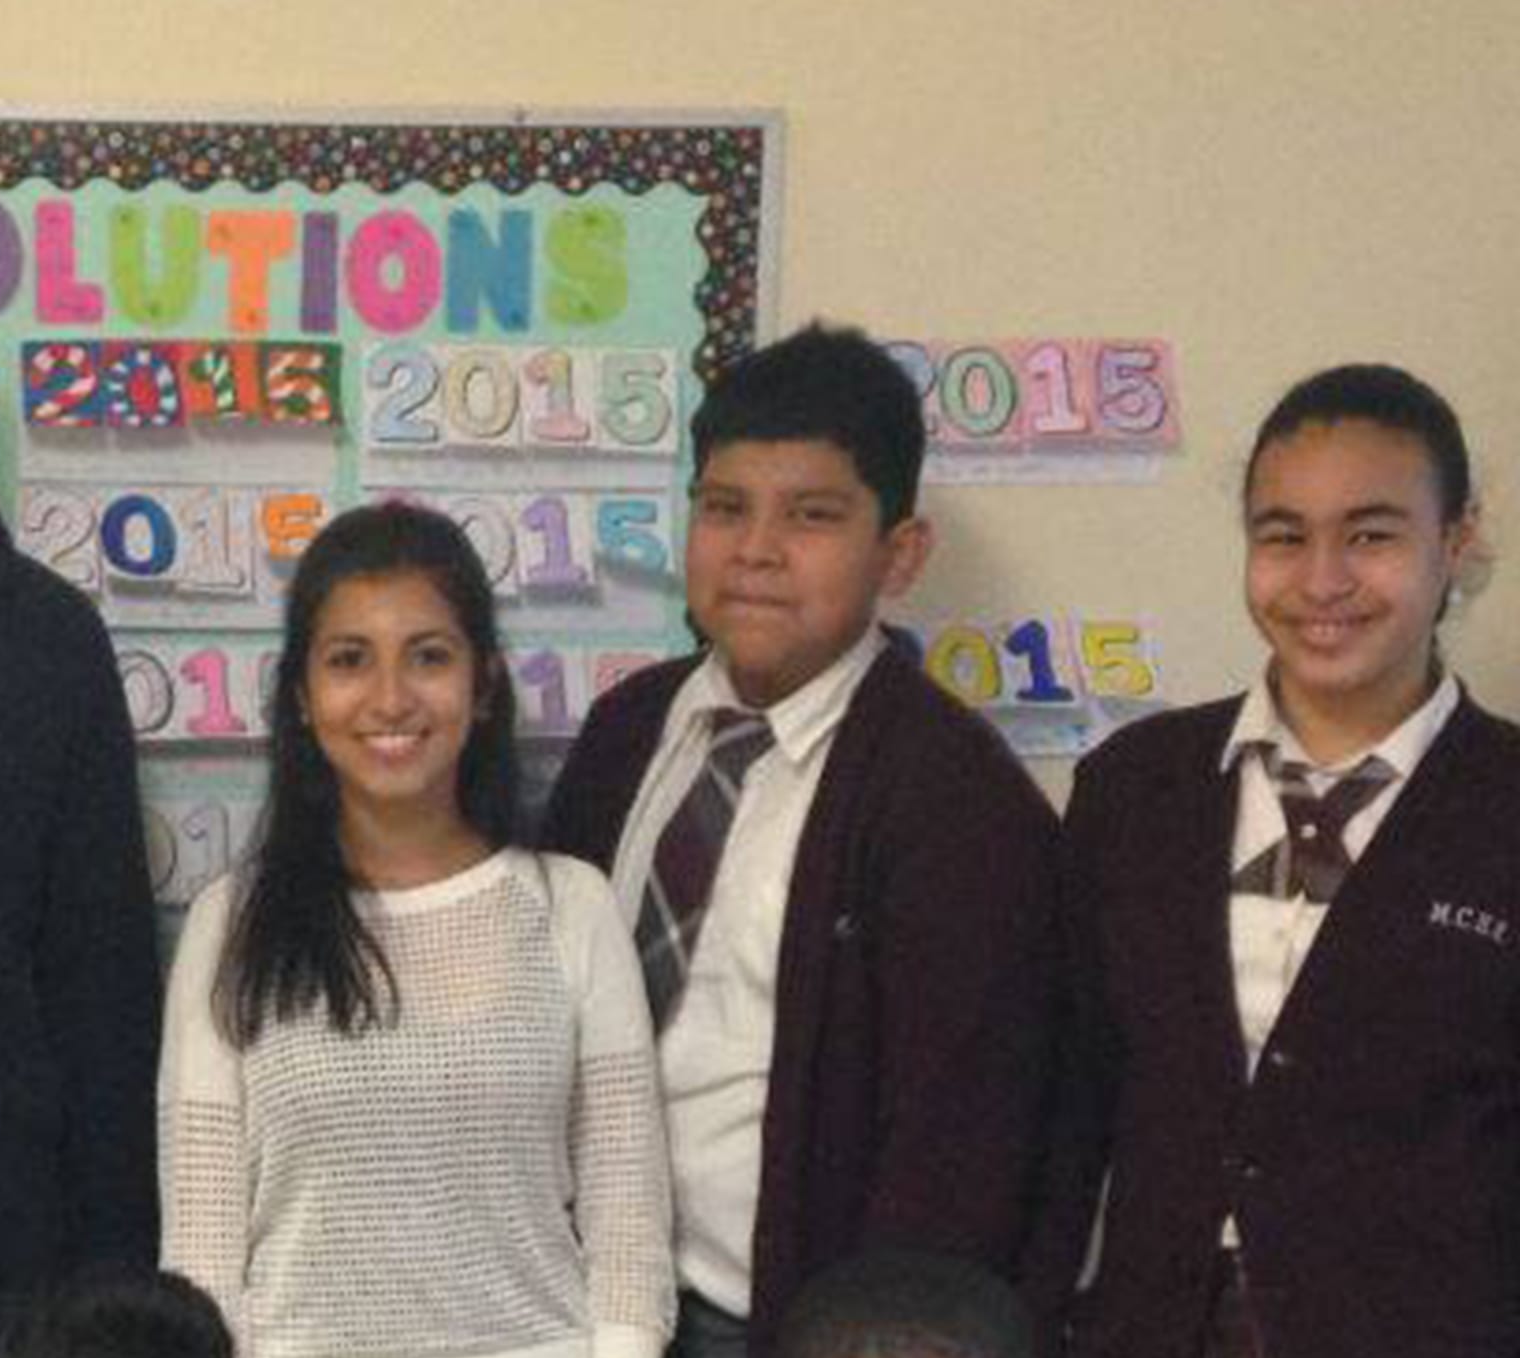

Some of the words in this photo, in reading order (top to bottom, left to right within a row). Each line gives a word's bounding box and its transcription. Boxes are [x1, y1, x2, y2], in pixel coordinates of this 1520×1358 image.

[29, 344, 332, 426] 2015
[366, 349, 671, 444] 2015
[376, 488, 668, 584] 015
[886, 619, 1154, 704] 015
